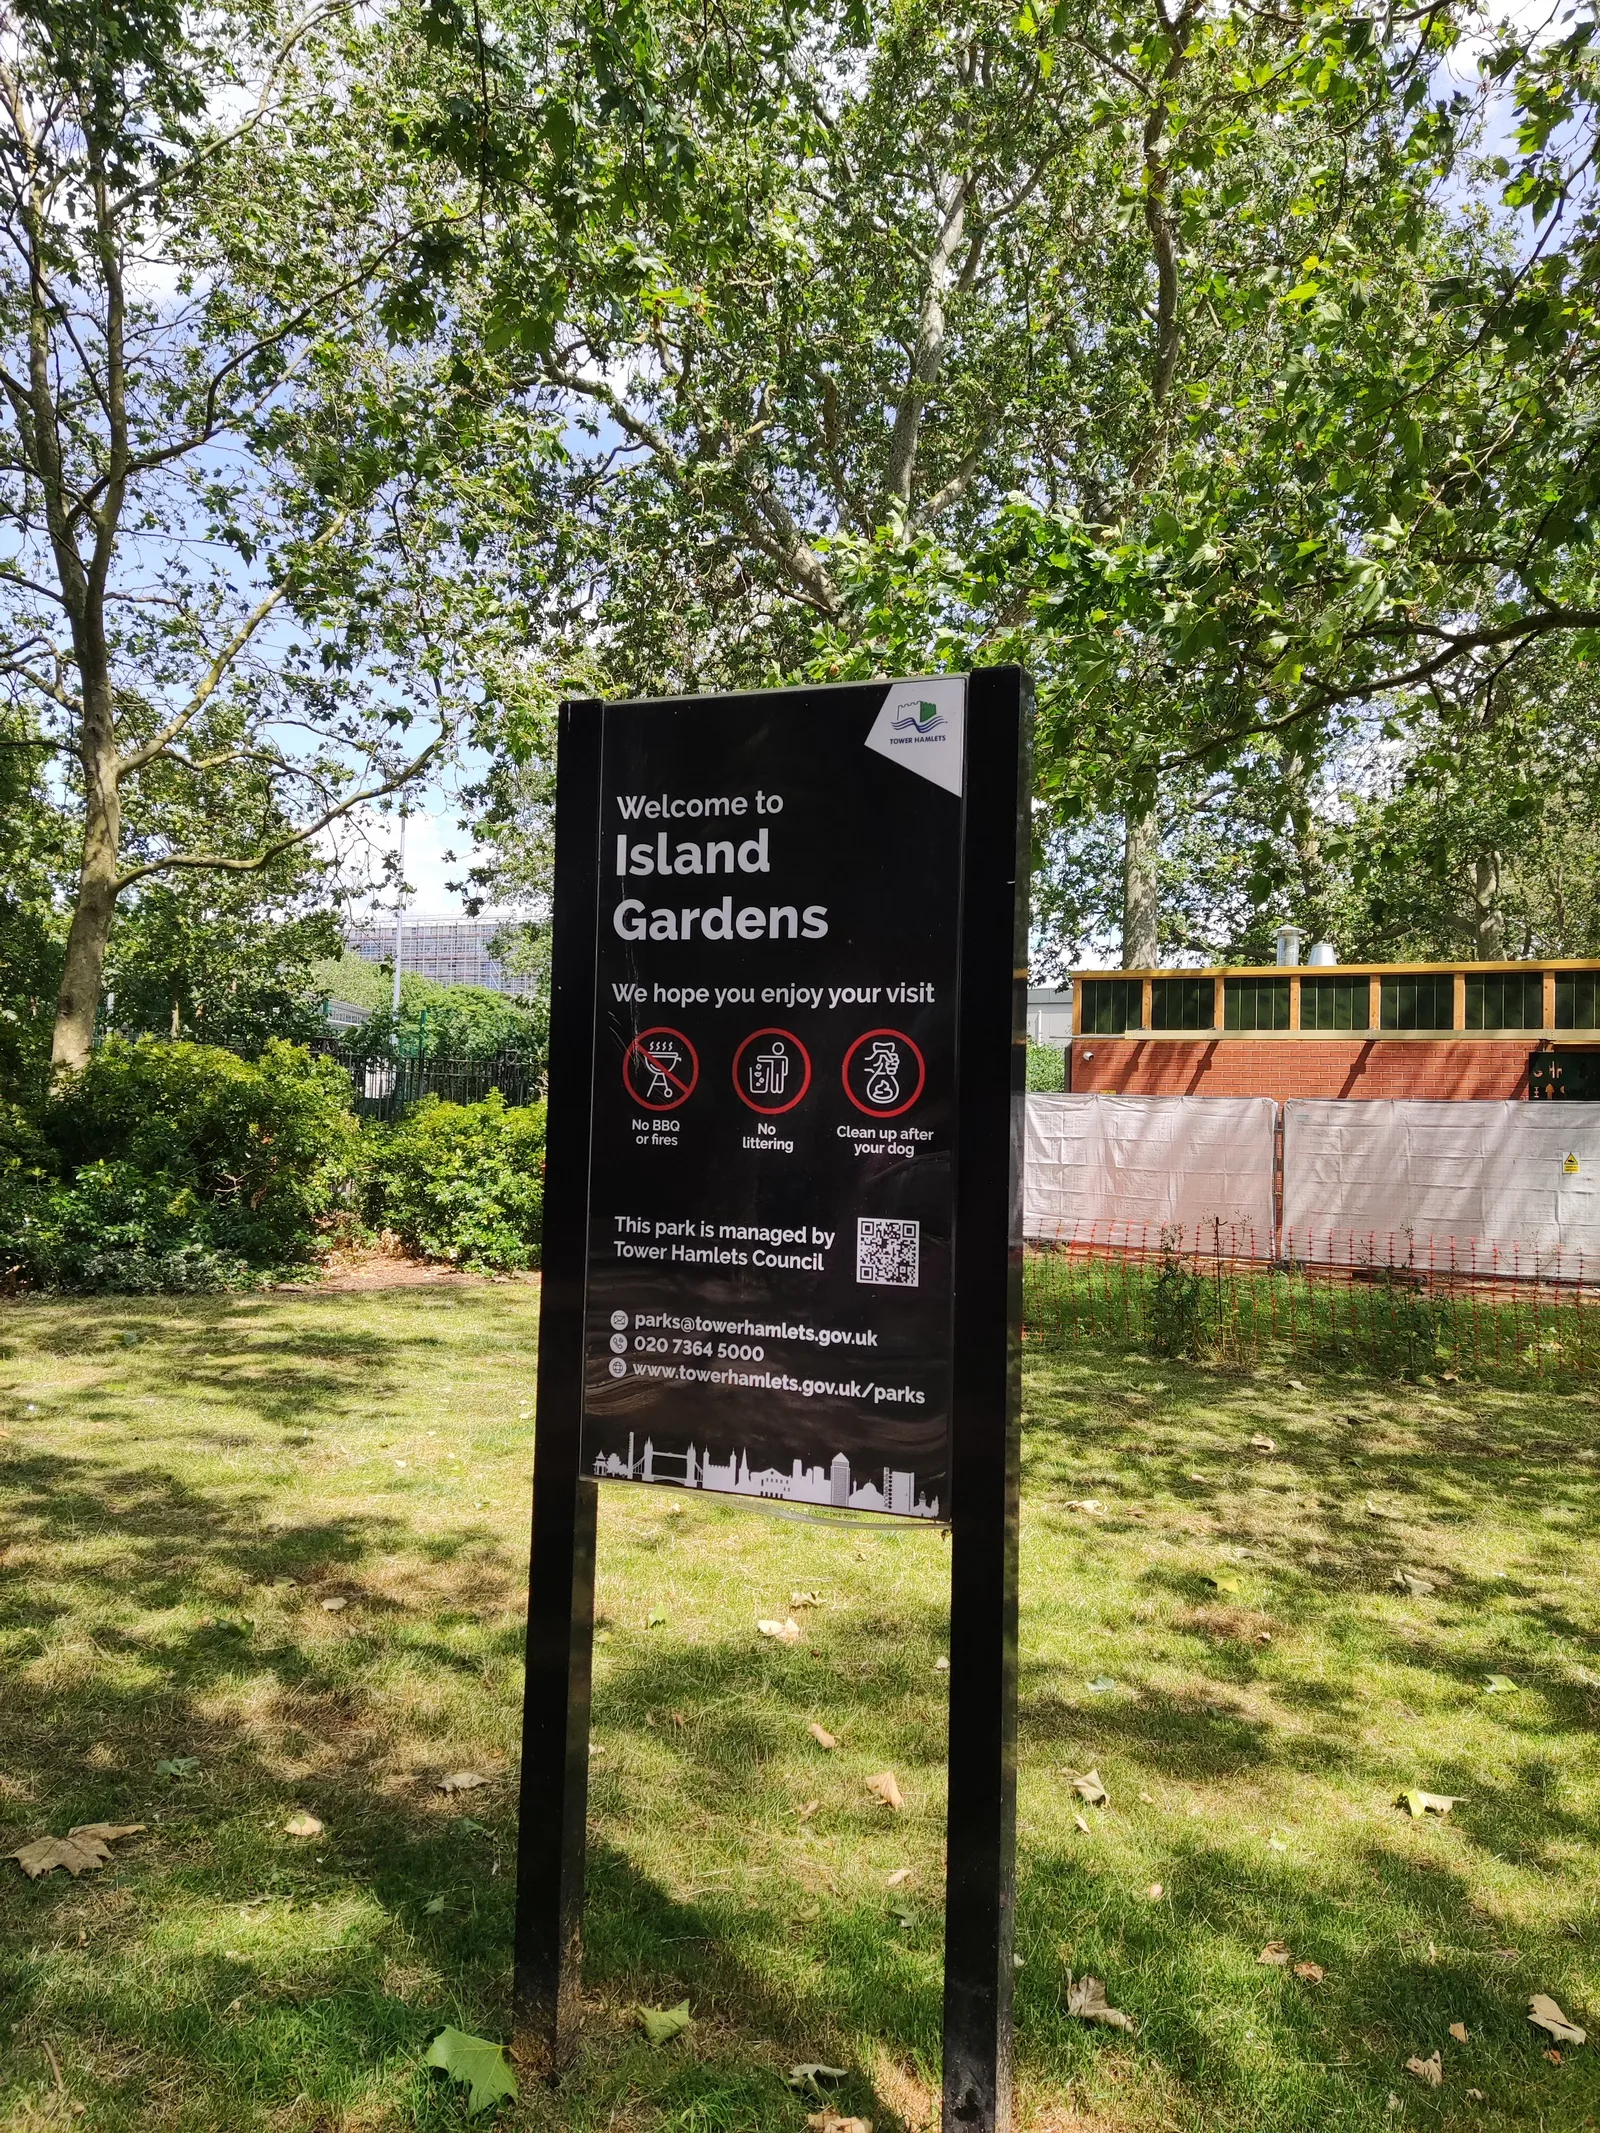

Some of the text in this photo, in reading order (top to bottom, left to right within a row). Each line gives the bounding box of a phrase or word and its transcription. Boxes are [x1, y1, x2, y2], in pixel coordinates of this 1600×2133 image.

[889, 735, 947, 745] TOWER HAMLETS
[616, 790, 784, 820] Welcome to
[616, 828, 770, 876] Island
[613, 896, 829, 941] Gardens
[612, 982, 936, 1009] We hope you enjoy your visit
[632, 1119, 681, 1132] No BBQ
[757, 1122, 776, 1136] No
[836, 1125, 934, 1143] Clean up after
[635, 1133, 678, 1146] or fires
[742, 1136, 794, 1154] littering
[854, 1142, 915, 1159] your dog
[614, 1216, 836, 1250] This park is managed by
[613, 1240, 825, 1271] Tower Hamlets Council
[635, 1312, 878, 1347] parks@towerhamlets.gov.uk
[634, 1335, 765, 1362] 020 7364 5000
[632, 1362, 926, 1404] www.towerhamlets.gov.uk/parks
